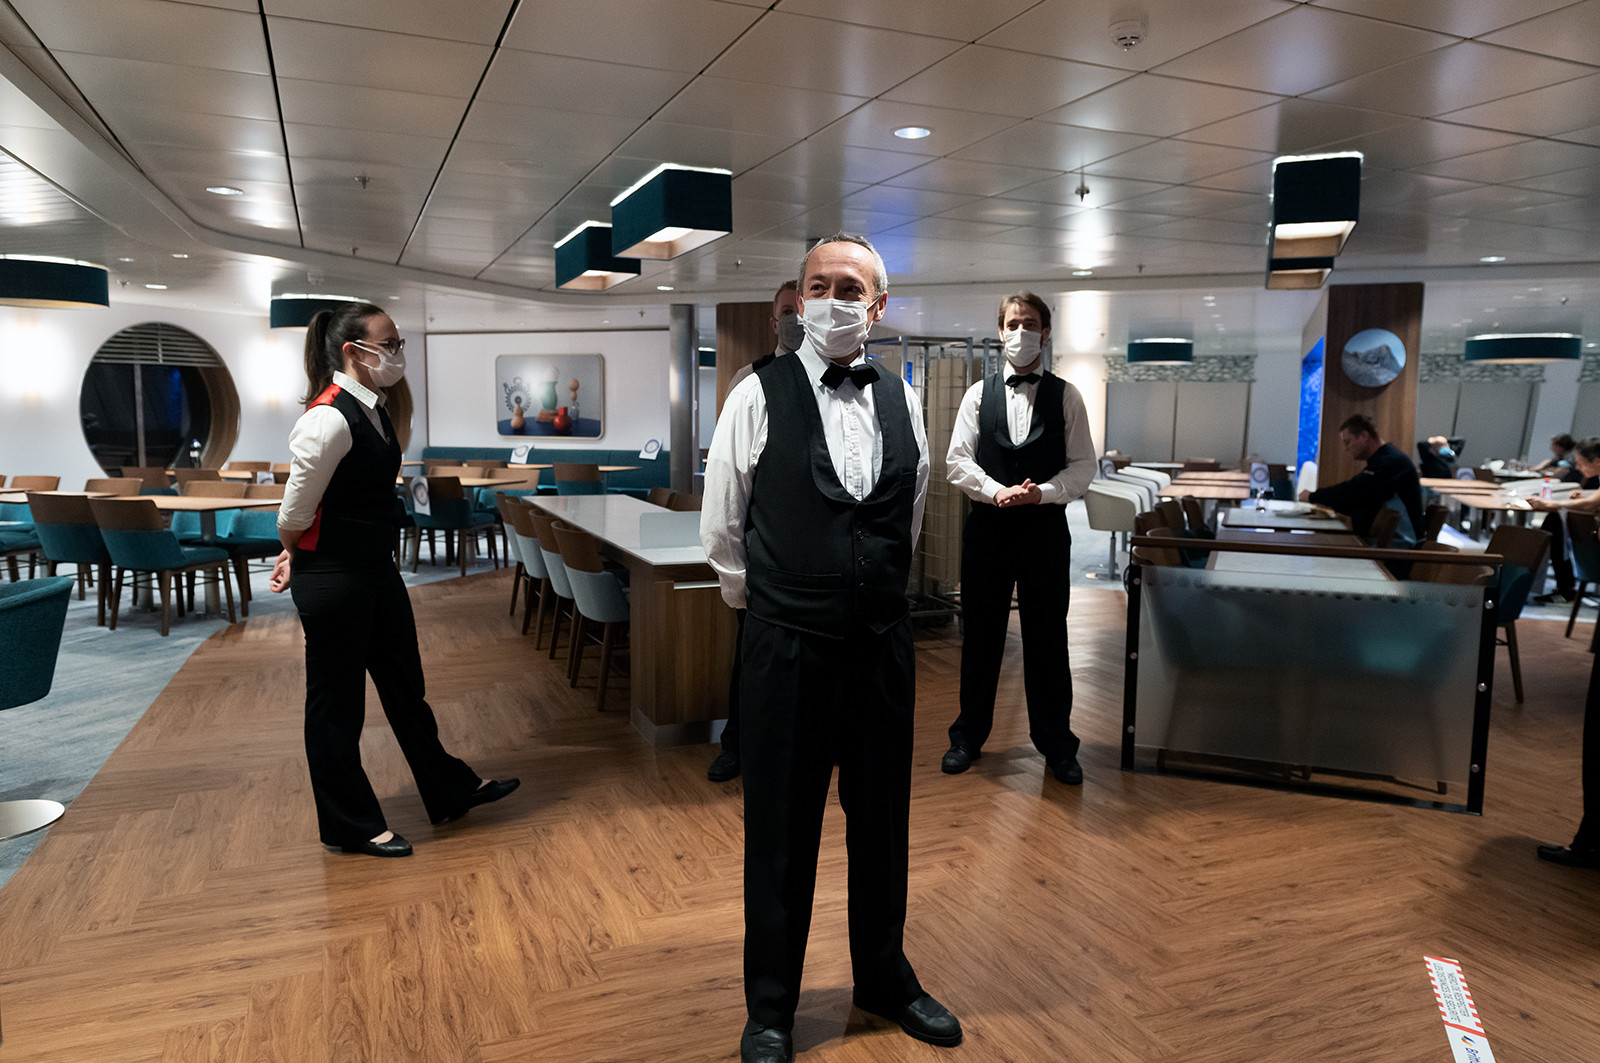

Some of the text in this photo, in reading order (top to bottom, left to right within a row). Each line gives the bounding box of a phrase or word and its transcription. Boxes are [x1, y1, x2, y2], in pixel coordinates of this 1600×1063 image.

[1433, 962, 1444, 971] LES
[1435, 970, 1451, 993] DISTANCES
[1442, 992, 1453, 1000] DE
[1453, 991, 1470, 1017] RESPECTER
